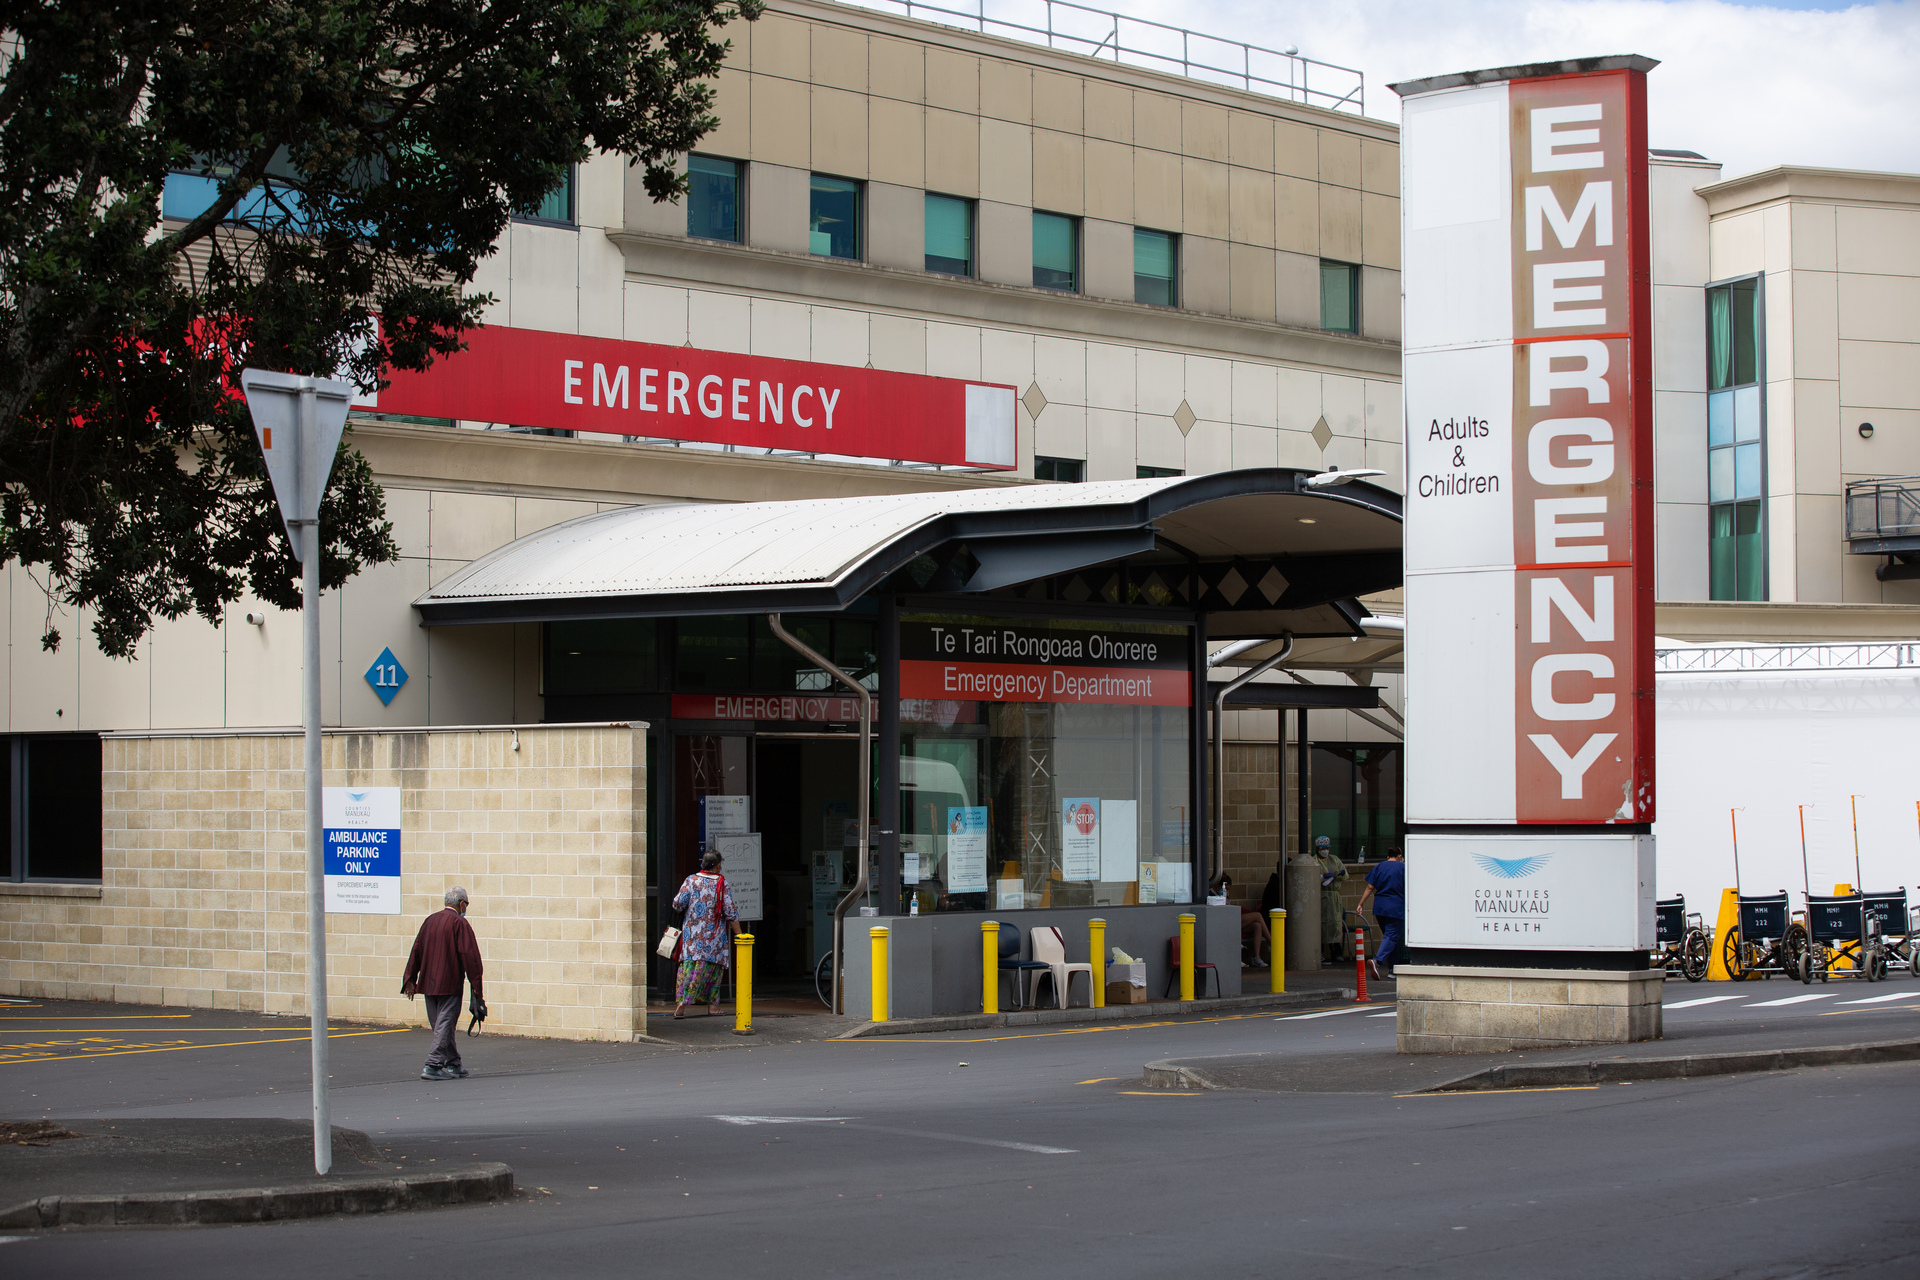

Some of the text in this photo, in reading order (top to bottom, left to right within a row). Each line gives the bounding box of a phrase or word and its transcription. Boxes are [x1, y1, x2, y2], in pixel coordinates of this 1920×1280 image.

[564, 359, 841, 430] EMERGENCY
[1428, 416, 1489, 441] Adults
[1452, 445, 1466, 467] &
[1526, 102, 1618, 800] EMERGENCY
[1418, 472, 1499, 498] Children
[931, 627, 1158, 662] Te Tari Rongoaa Ohorere
[375, 664, 399, 687] 11
[944, 667, 1152, 700] Emergency Department
[715, 697, 829, 719] EMERGENCY
[1076, 813, 1095, 825] STOP
[328, 831, 388, 843] AMBULANCE
[337, 846, 379, 858] PARKING
[344, 861, 371, 874] ONLY
[1474, 889, 1549, 899] COUNTIES
[1474, 900, 1549, 914] MANUKAU
[1483, 922, 1541, 932] HEALTH
